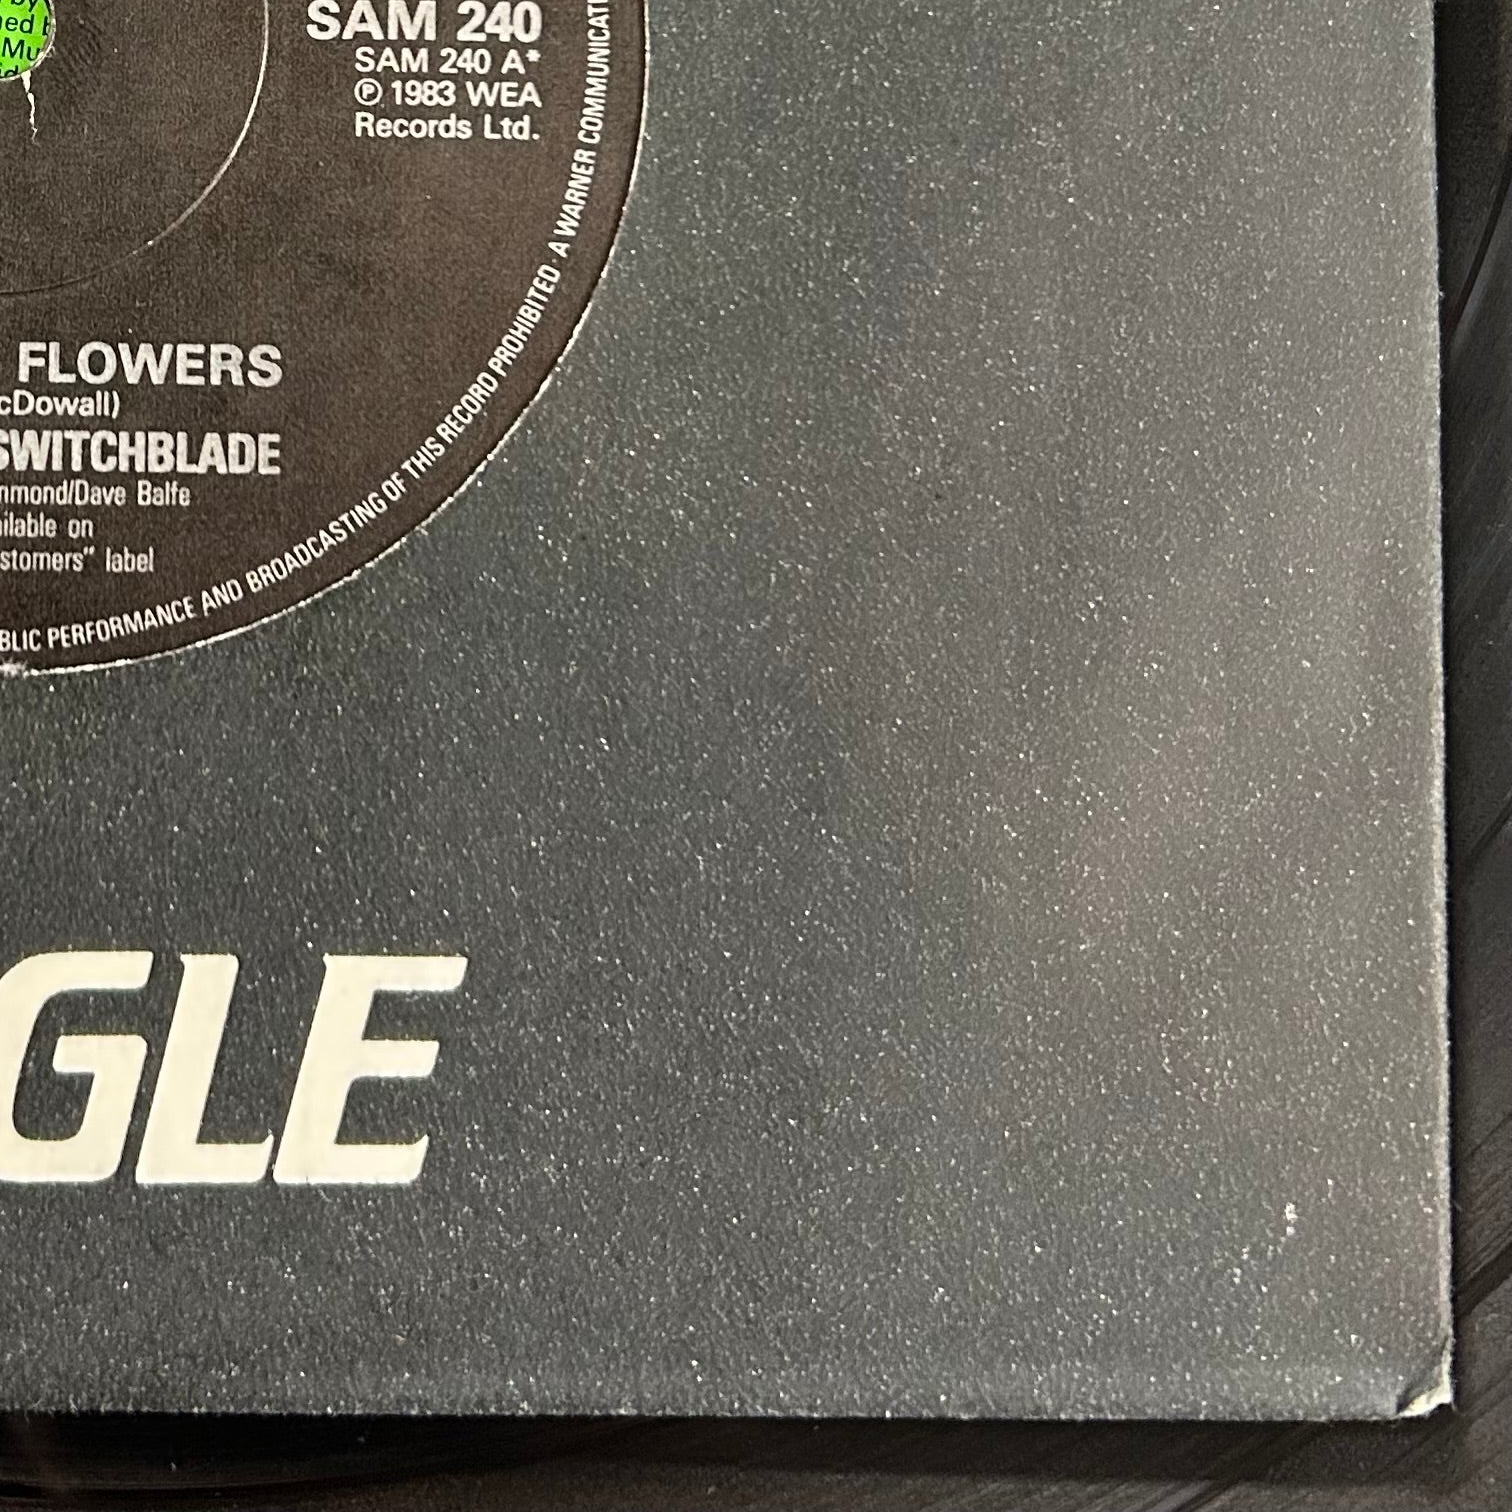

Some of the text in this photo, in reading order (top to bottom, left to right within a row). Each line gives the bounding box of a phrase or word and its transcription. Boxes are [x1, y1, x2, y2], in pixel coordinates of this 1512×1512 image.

[306, 0, 543, 44] SAM 240
[354, 47, 429, 74] SAM
[439, 48, 491, 75] 240
[391, 80, 456, 107] 1983
[466, 82, 543, 108] WEA
[355, 112, 541, 141] Records Ltd.
[552, 148, 597, 237] WARNER
[548, 240, 571, 258] A
[488, 263, 561, 377] PROHIBITED
[18, 341, 284, 388] FLOWERS
[435, 371, 499, 445] RECORD
[400, 440, 446, 481] THIS
[137, 479, 191, 507] Balfe
[380, 472, 408, 503] OF
[67, 518, 94, 538] on
[245, 491, 389, 594] BROADCASTING
[105, 546, 155, 573] label
[200, 578, 244, 618] AND
[47, 596, 197, 651] PERFORMANCE
